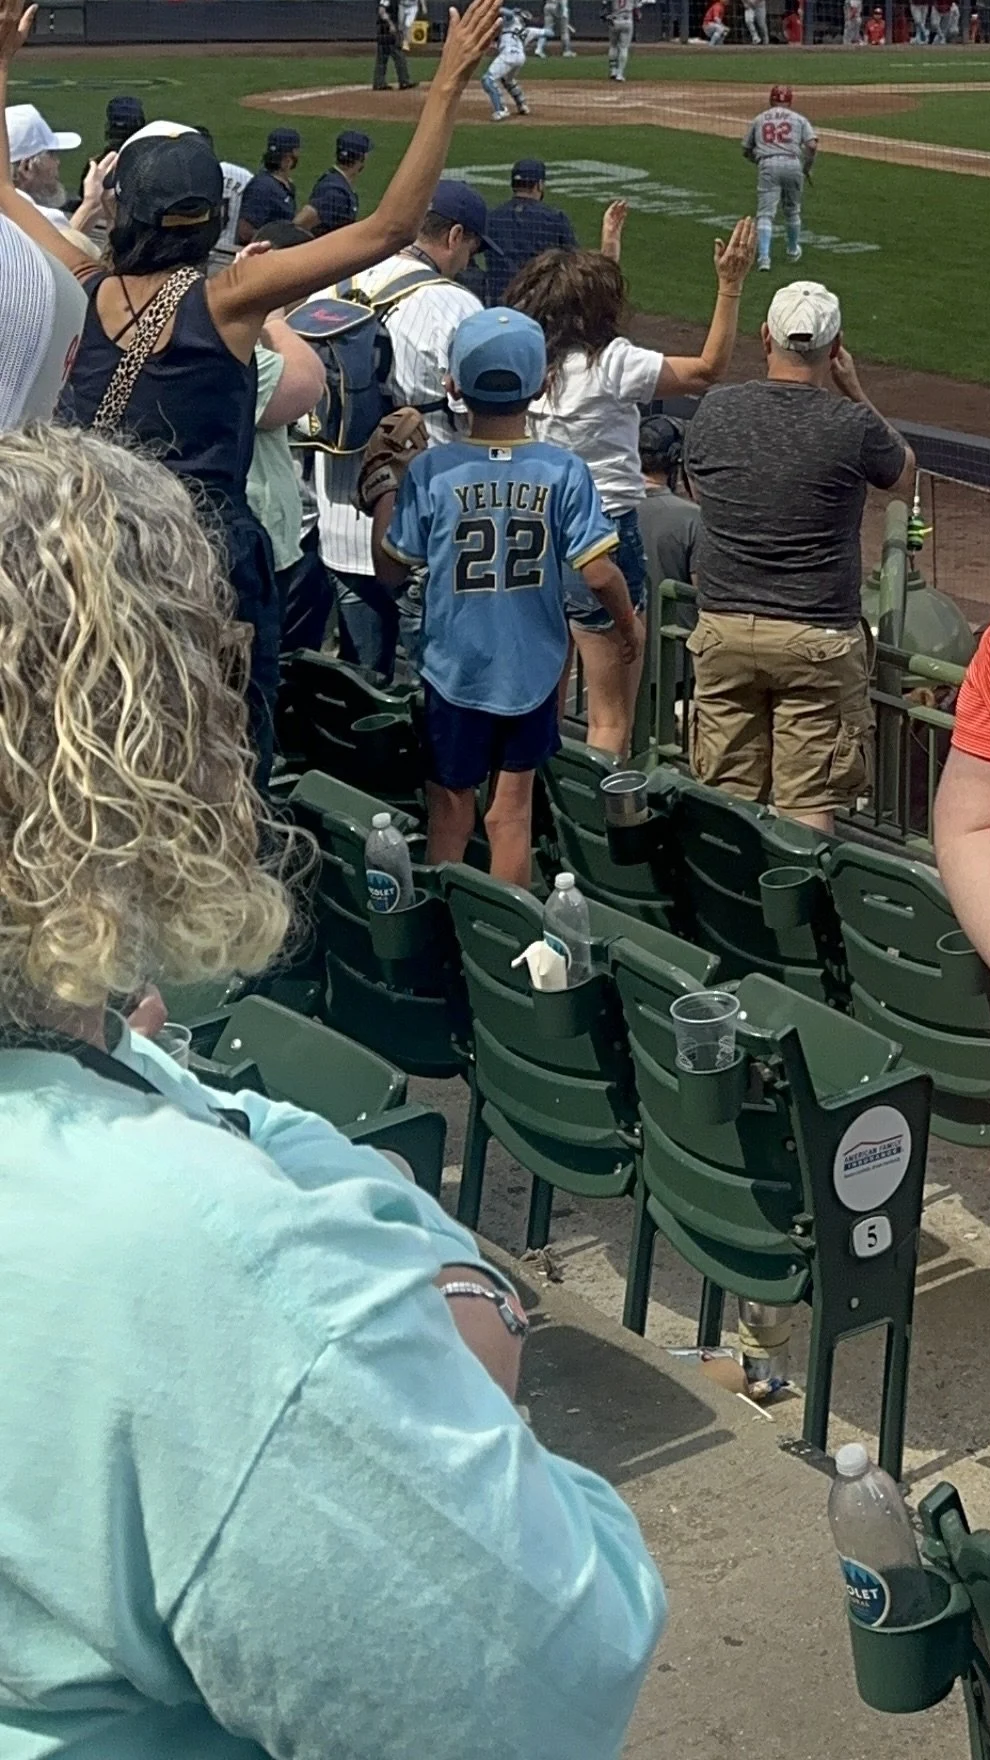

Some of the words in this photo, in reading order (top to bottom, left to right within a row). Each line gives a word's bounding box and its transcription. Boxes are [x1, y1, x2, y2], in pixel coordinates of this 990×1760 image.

[762, 122, 793, 144] 82
[453, 481, 551, 515] YELICH
[453, 515, 549, 594] 22
[844, 1146, 878, 1162] AMERICAN
[879, 1139, 903, 1151] FAMILY
[866, 1224, 878, 1249] 5
